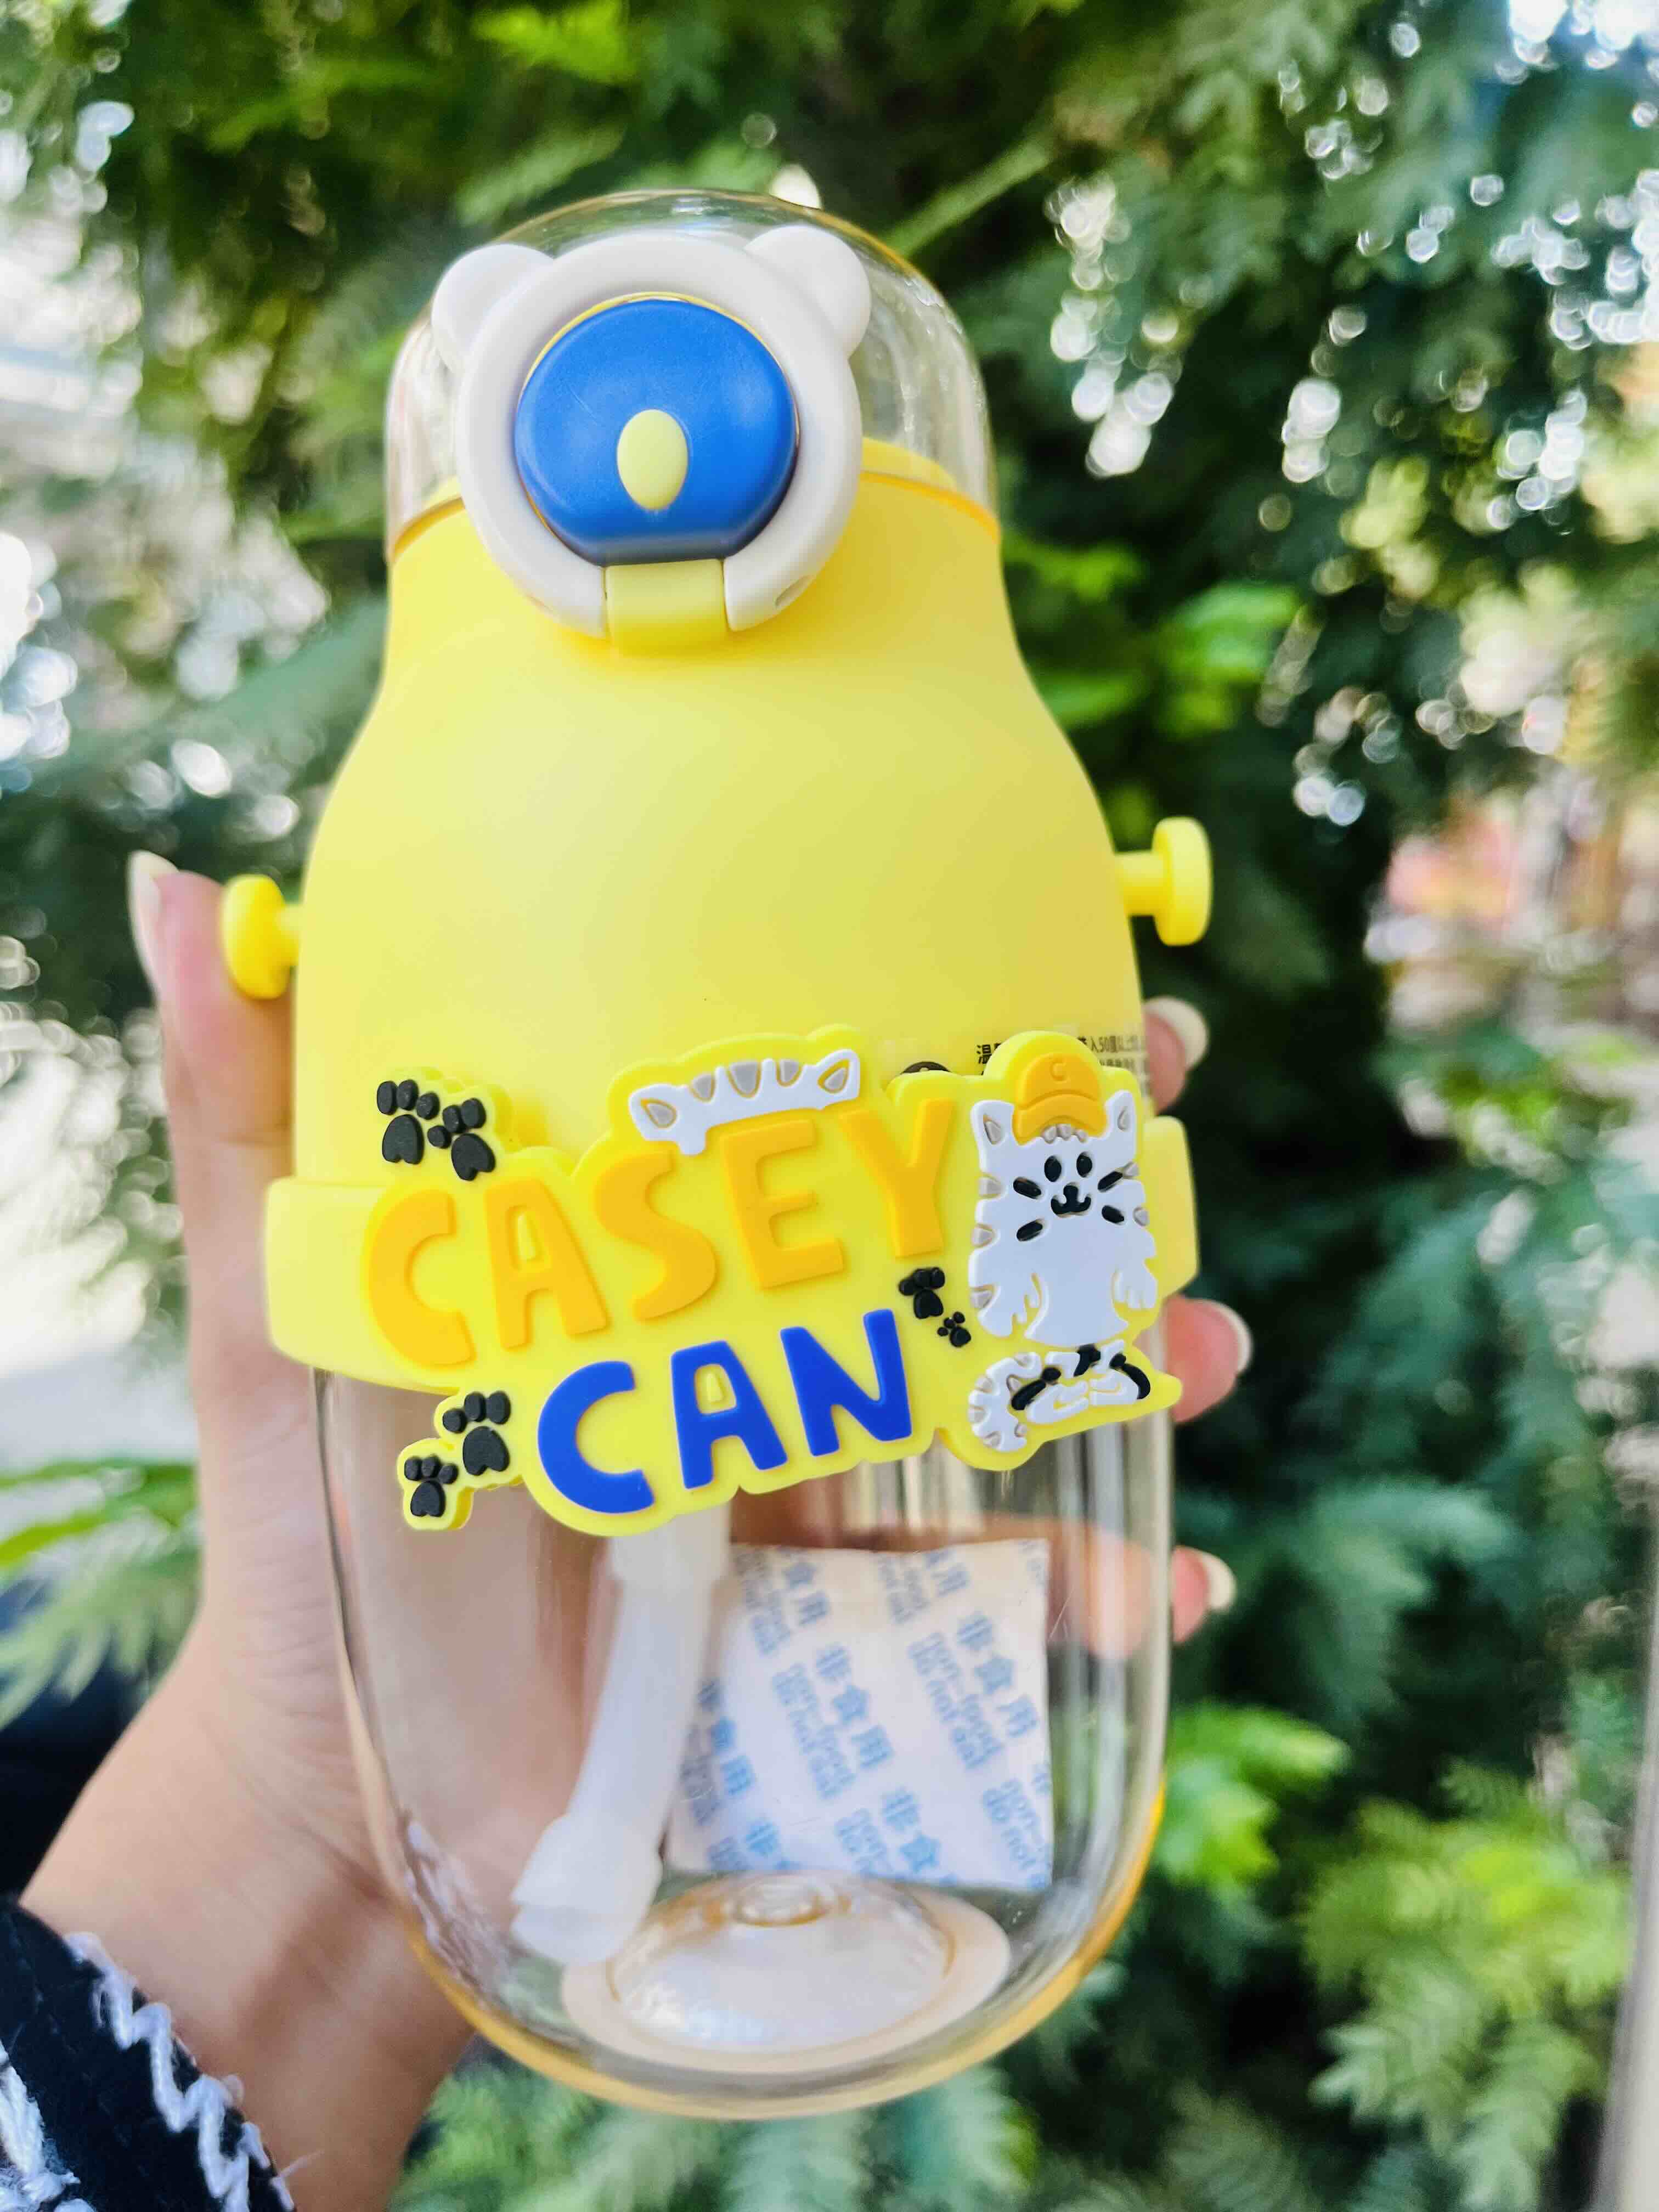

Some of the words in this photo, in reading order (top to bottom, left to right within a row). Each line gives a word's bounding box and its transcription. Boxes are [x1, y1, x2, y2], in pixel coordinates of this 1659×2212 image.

[368, 1097, 956, 1367] CASEY
[538, 1308, 912, 1514] CAN
[816, 1646, 894, 1770] 非食用
[956, 1613, 1039, 1739] 非食用
